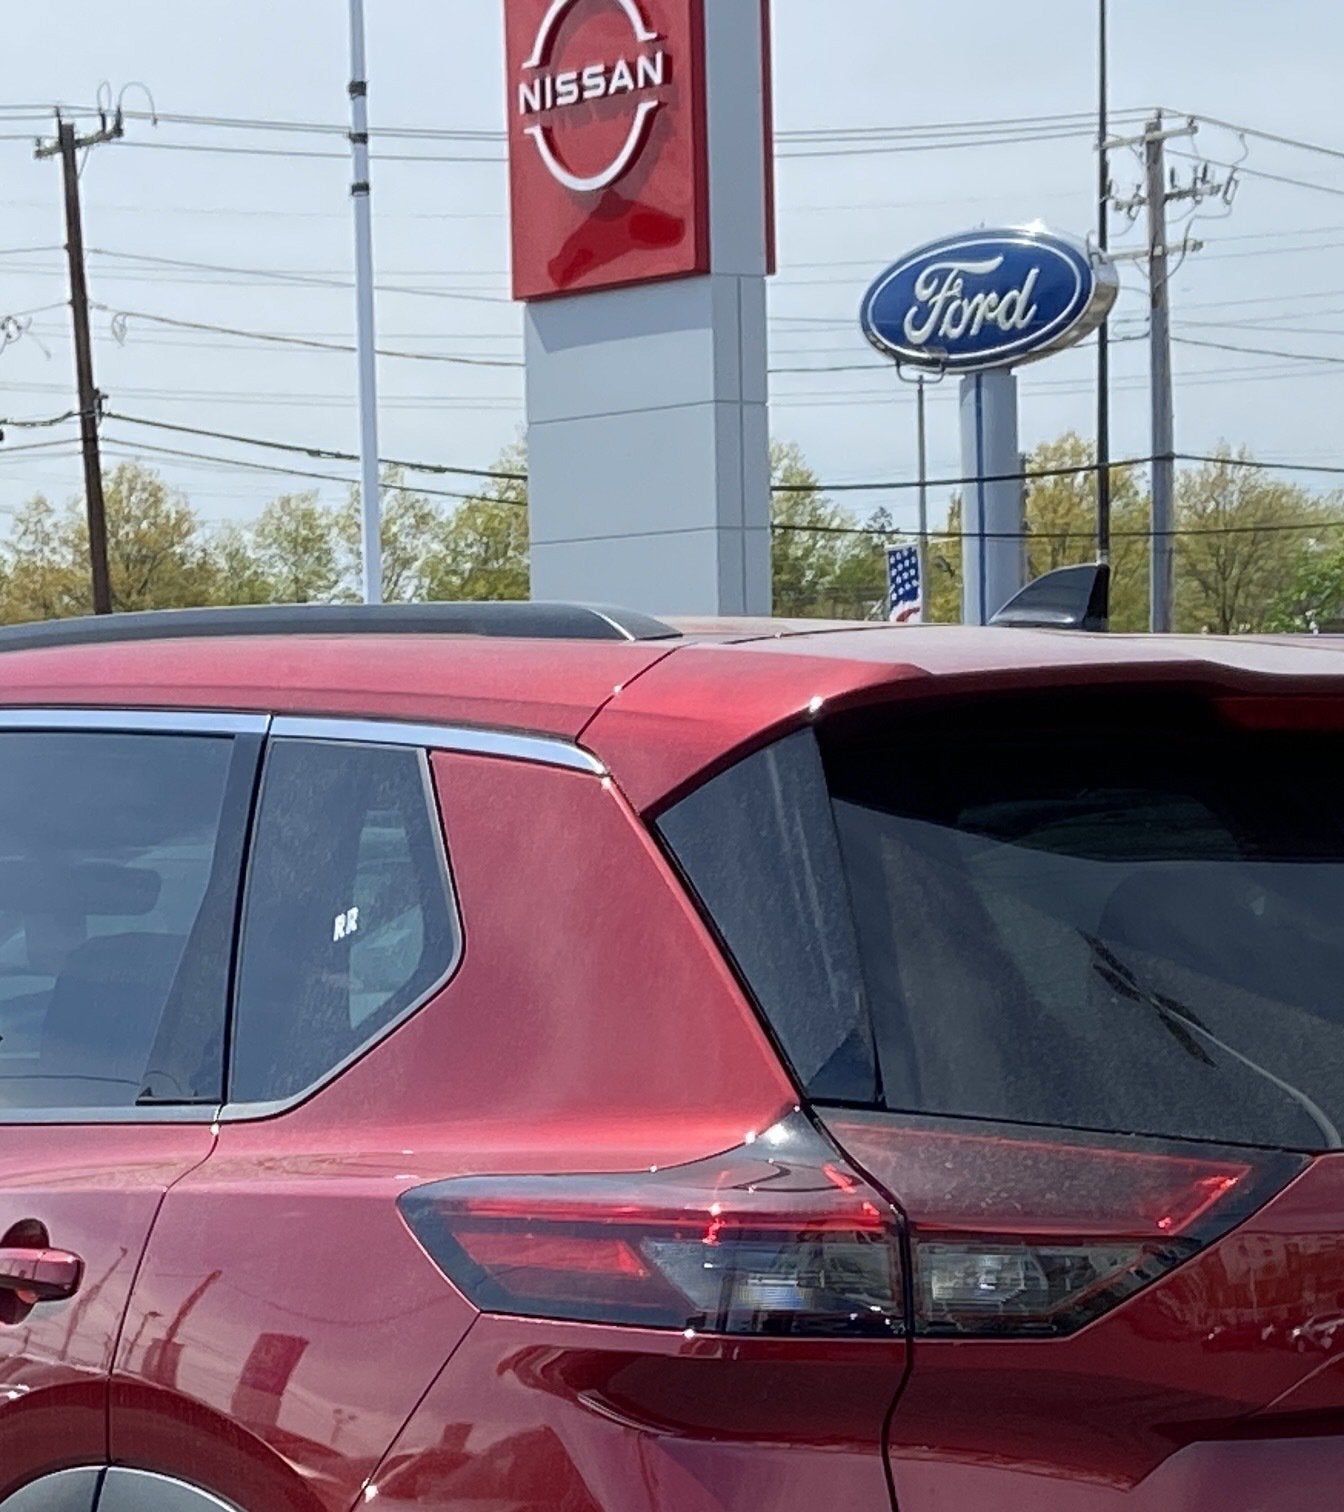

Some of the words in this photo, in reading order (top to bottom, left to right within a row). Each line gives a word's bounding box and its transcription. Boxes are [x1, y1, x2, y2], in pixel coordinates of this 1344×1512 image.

[519, 50, 664, 115] NISSAN
[903, 254, 1040, 345] Ford
[333, 906, 359, 942] RR
